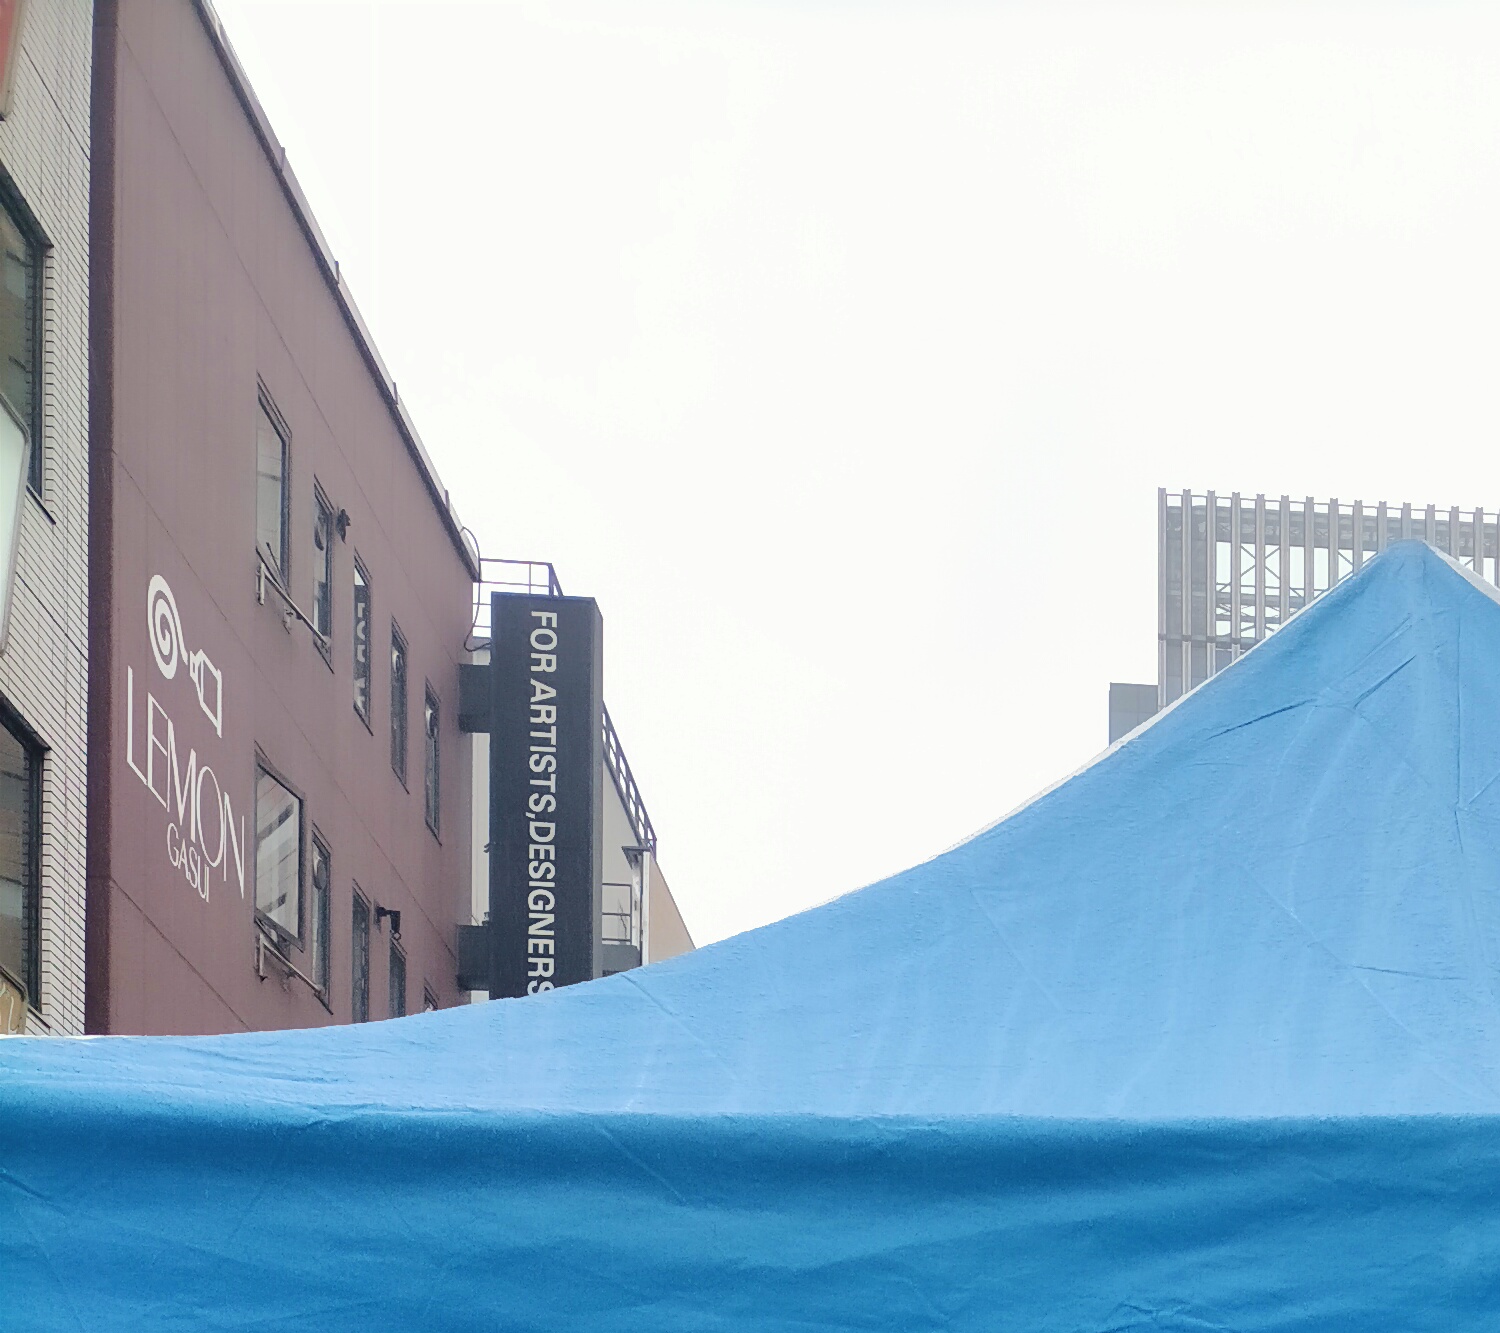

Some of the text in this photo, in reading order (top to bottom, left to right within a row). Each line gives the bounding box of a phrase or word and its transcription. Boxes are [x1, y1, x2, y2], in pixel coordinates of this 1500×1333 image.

[529, 610, 558, 673] FOR
[126, 665, 245, 900] LEMON
[166, 822, 210, 903] GASUI
